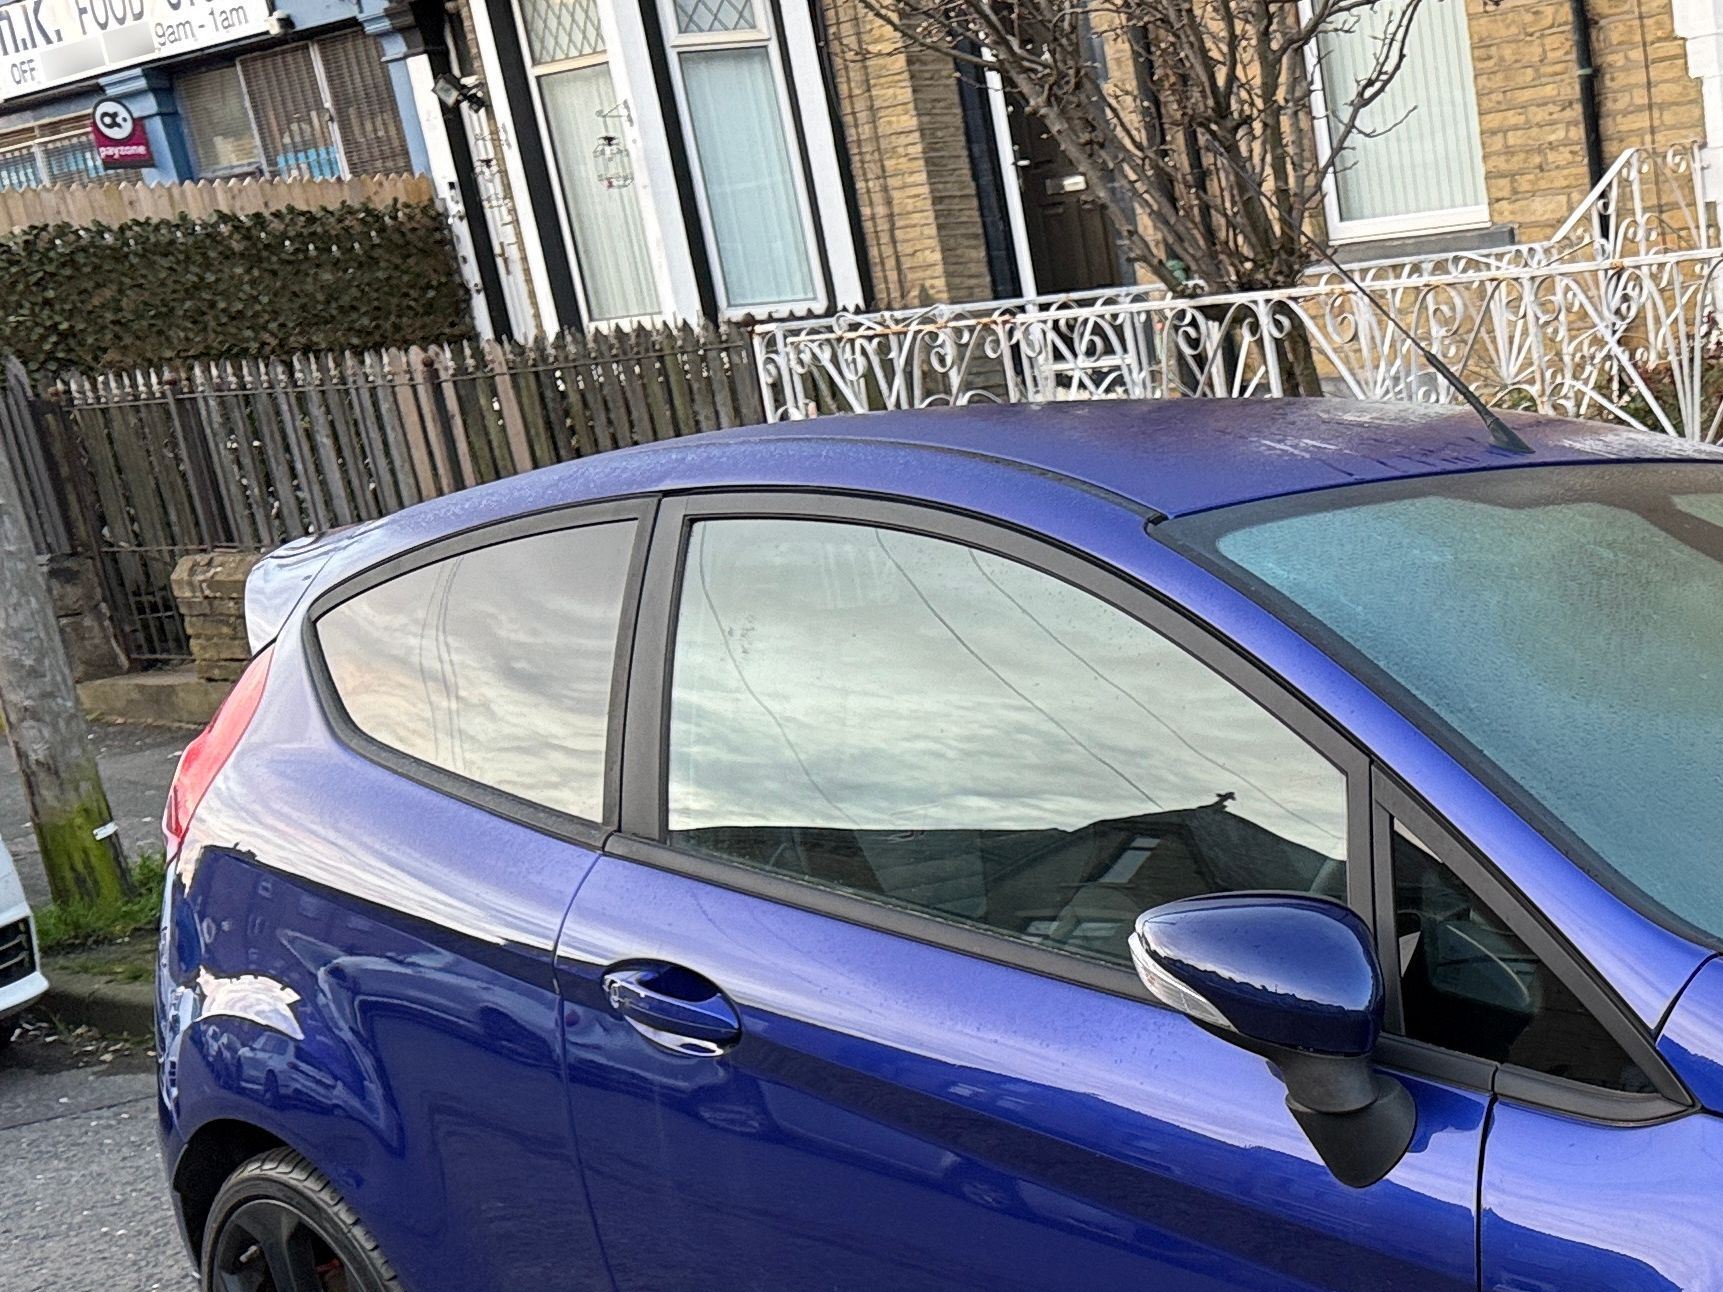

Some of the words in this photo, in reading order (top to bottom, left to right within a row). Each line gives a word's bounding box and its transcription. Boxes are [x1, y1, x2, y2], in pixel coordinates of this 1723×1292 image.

[10, 59, 36, 85] OFF
[154, 20, 196, 47] 9am
[208, 5, 248, 32] 1am
